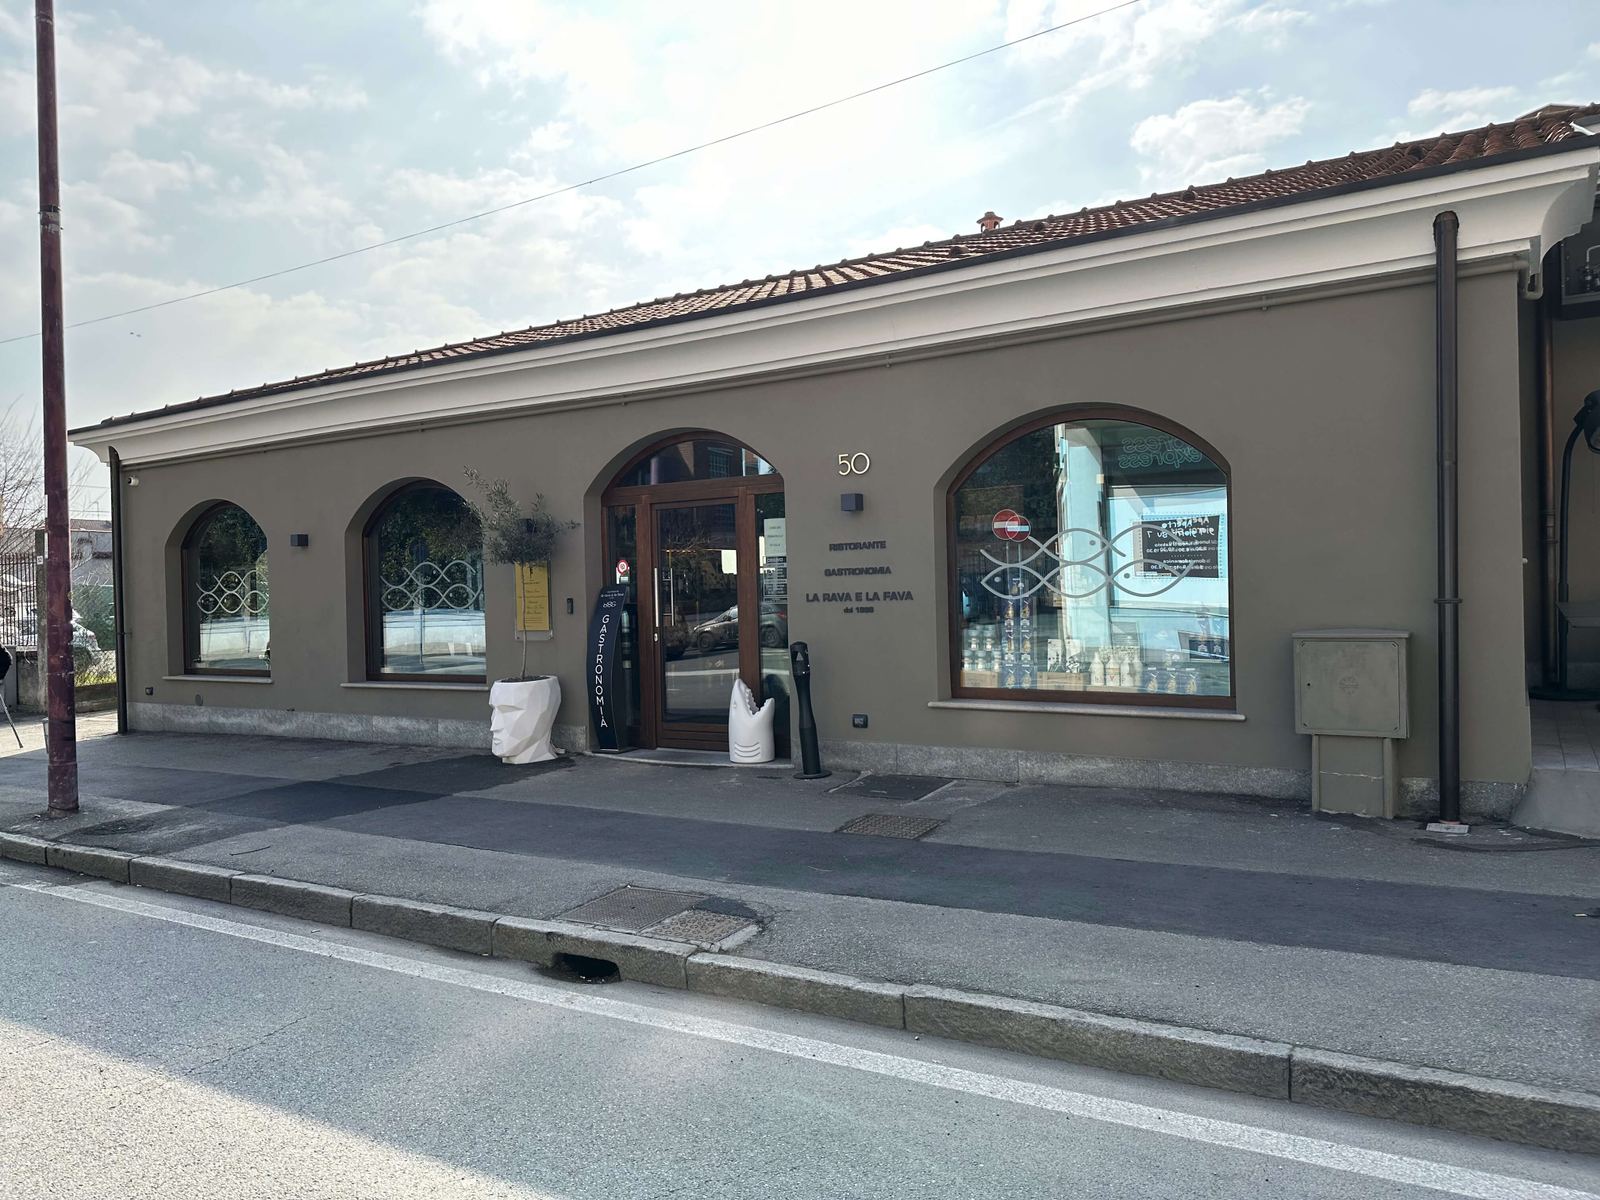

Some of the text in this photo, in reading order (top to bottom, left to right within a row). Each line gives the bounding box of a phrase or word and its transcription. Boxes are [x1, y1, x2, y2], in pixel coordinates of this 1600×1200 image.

[838, 452, 870, 476] 50
[829, 540, 887, 552] RISTORANTE
[824, 566, 892, 577] GASTRONOMIA
[806, 591, 914, 603] LA RAVA E LA FAVA
[595, 614, 610, 728] GASTRONOMIA
